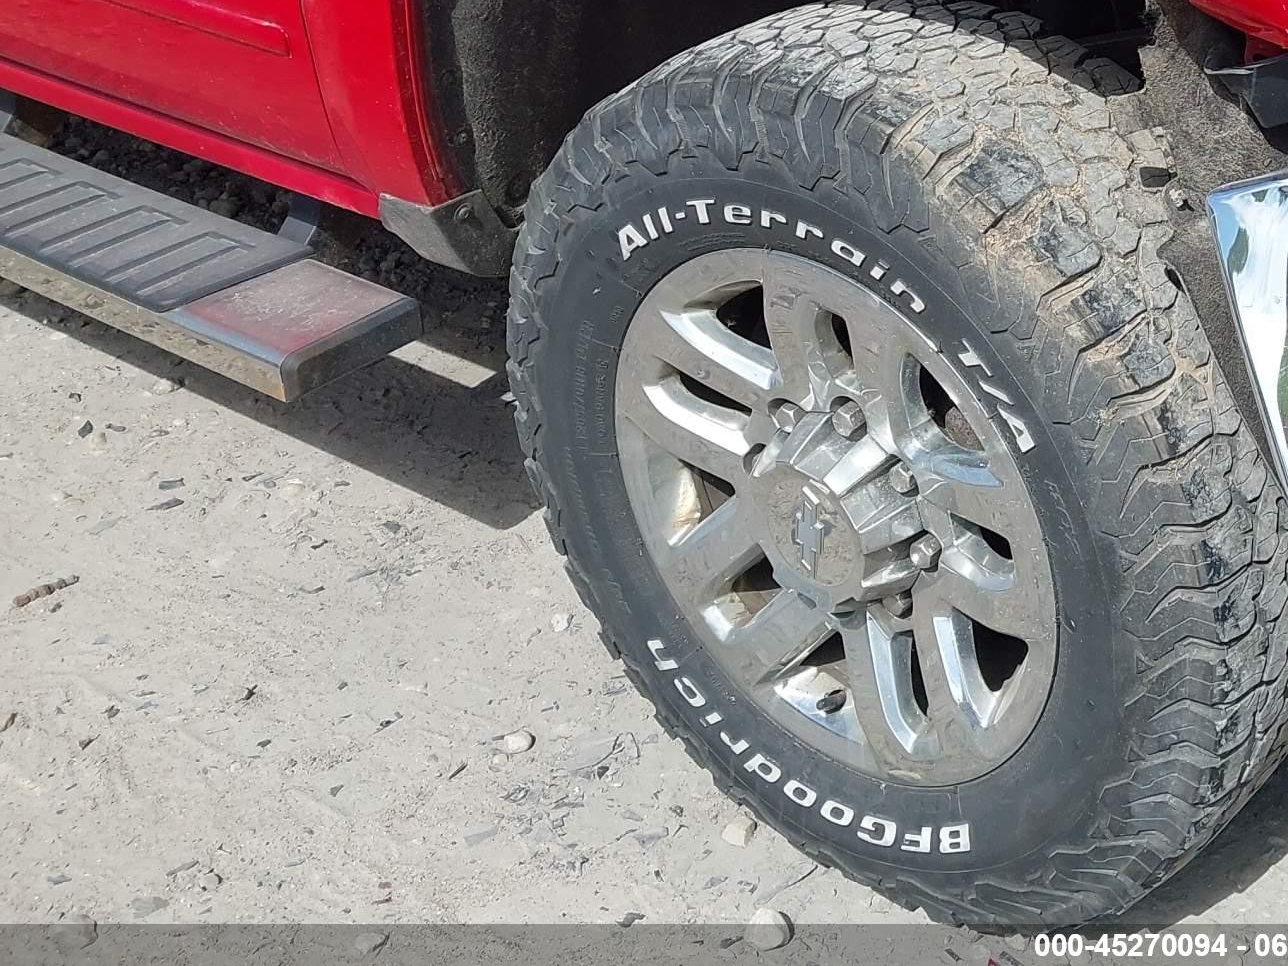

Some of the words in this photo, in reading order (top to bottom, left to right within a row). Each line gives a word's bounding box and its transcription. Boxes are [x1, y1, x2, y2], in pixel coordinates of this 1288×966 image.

[617, 198, 928, 314] All-Terrain
[957, 338, 1036, 453] T/A
[646, 639, 972, 855] BFGoodrich
